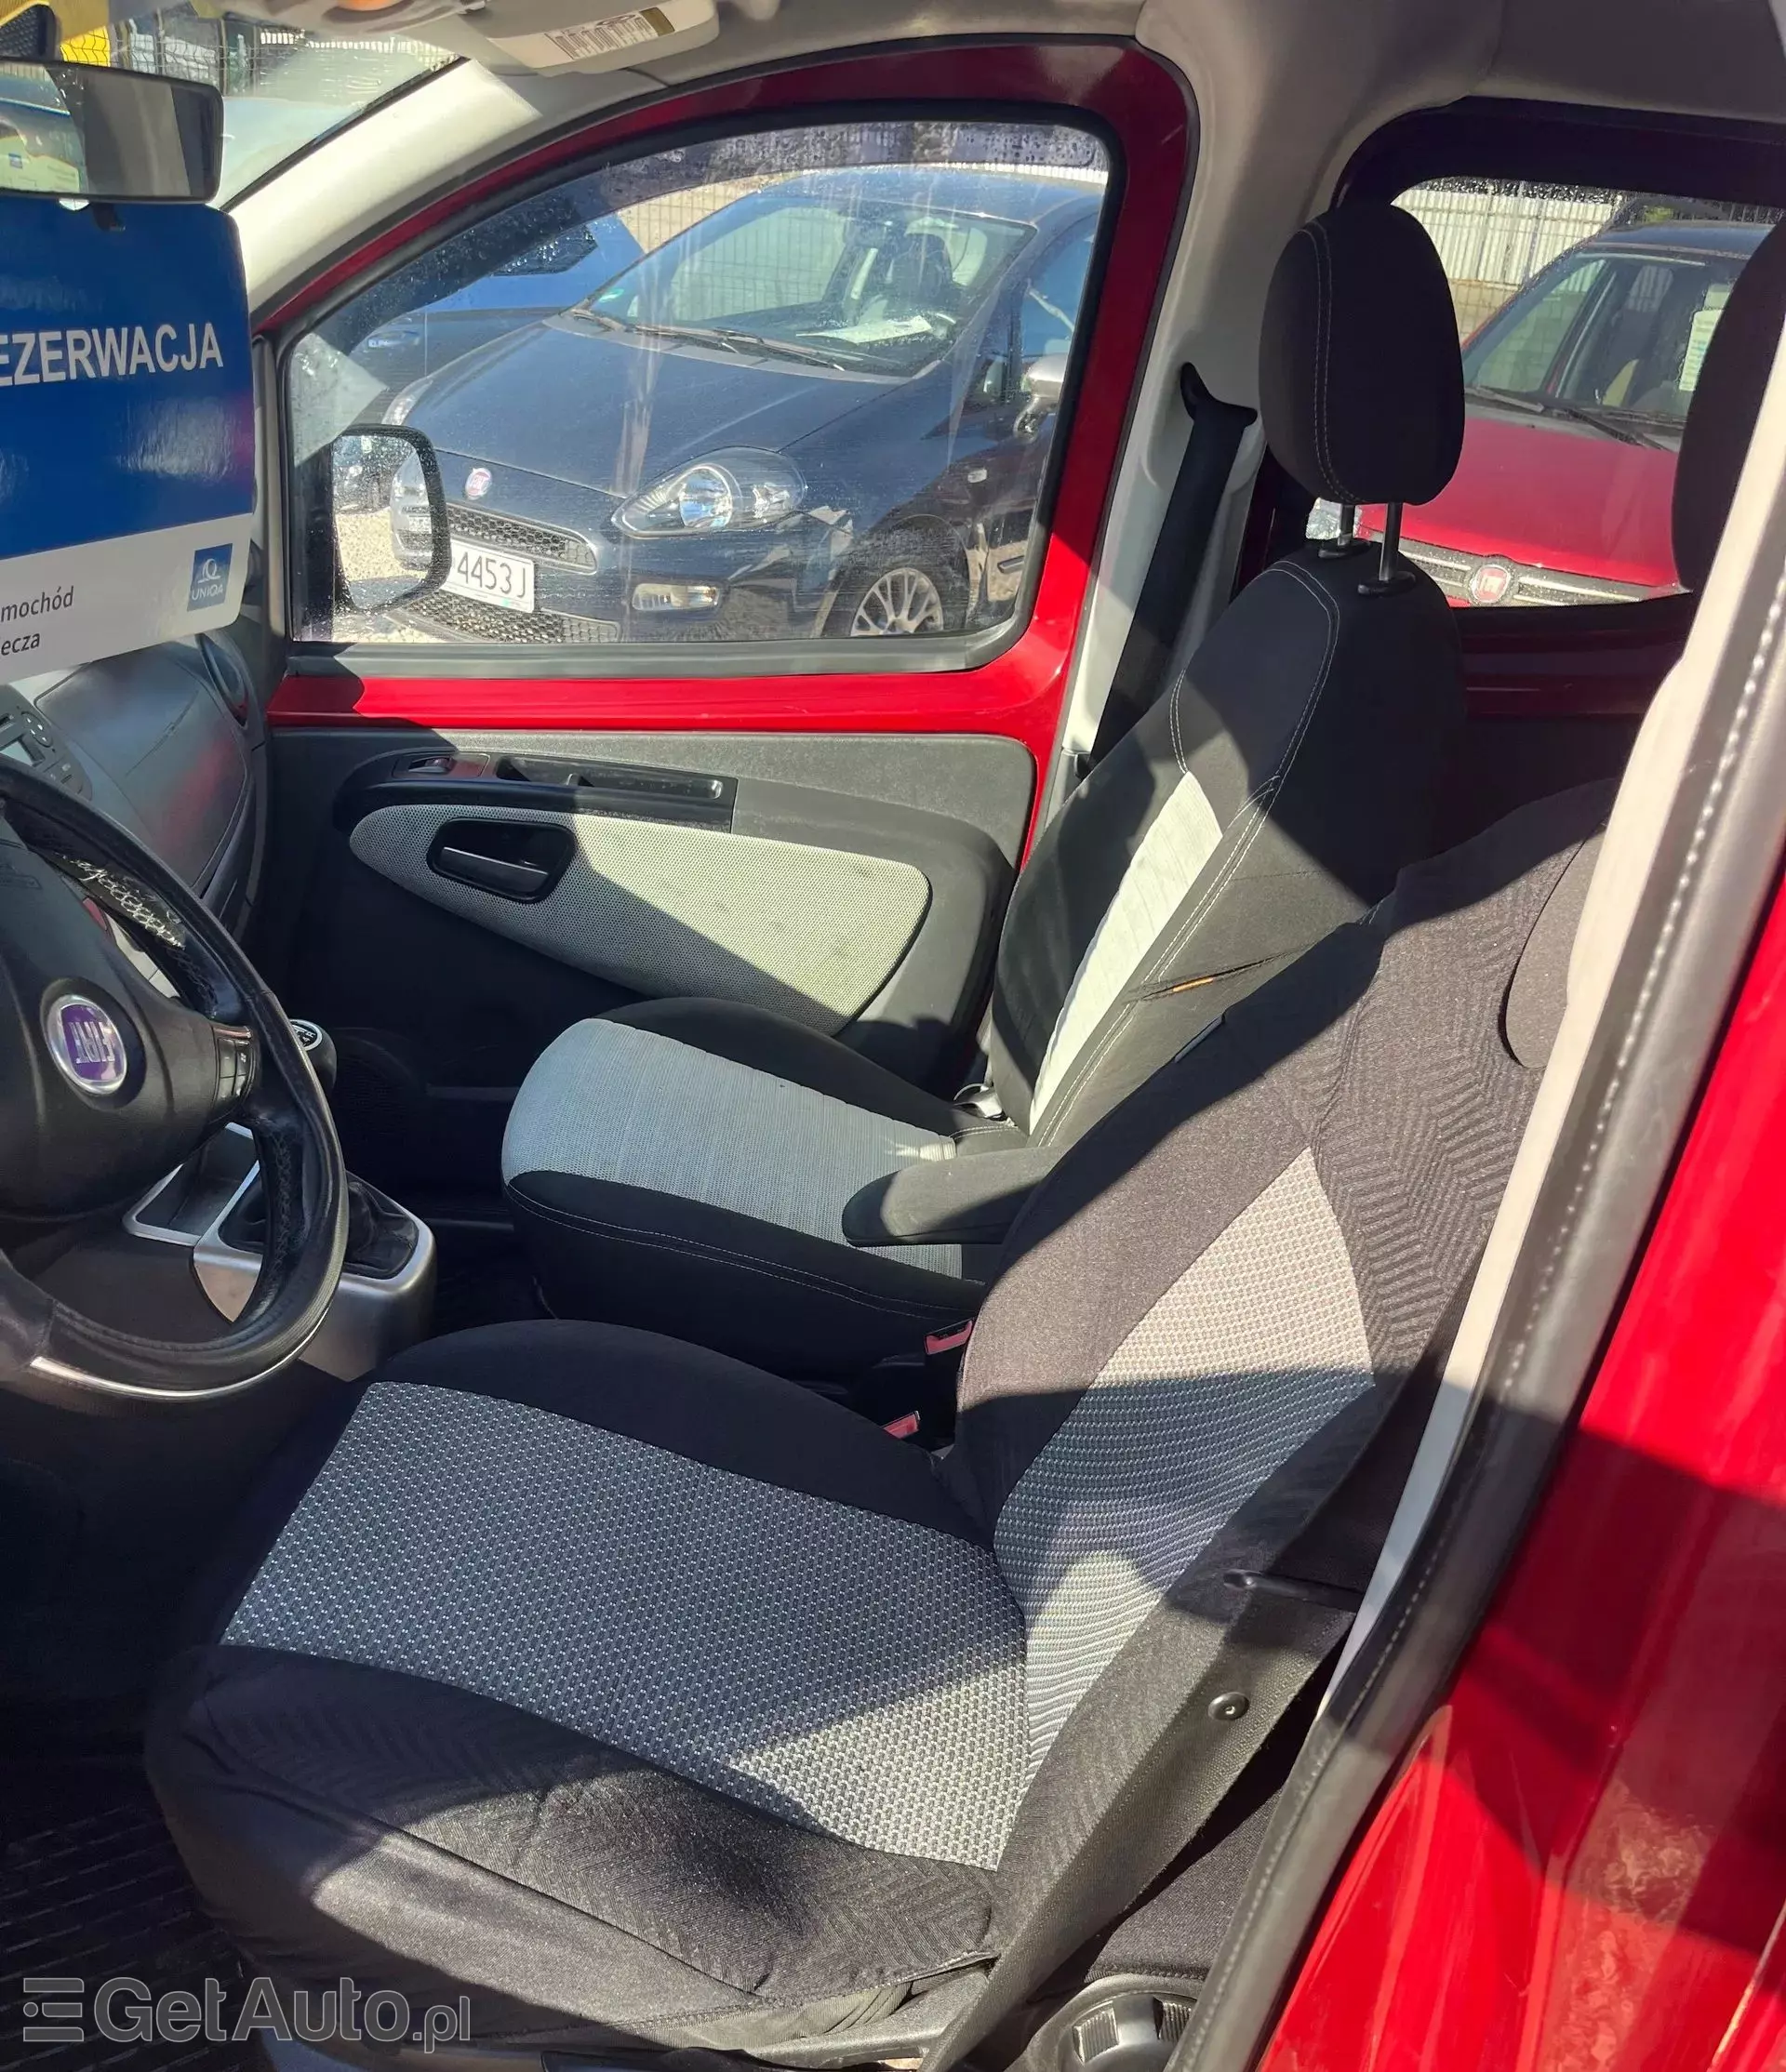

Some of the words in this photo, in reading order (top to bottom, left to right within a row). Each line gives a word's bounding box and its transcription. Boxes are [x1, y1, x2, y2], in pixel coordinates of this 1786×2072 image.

[191, 584, 223, 601] UNIQA
[457, 551, 526, 598] 4453J
[1, 585, 74, 622] mochód
[1, 632, 41, 657] ecza
[68, 1021, 115, 1064] FIAT
